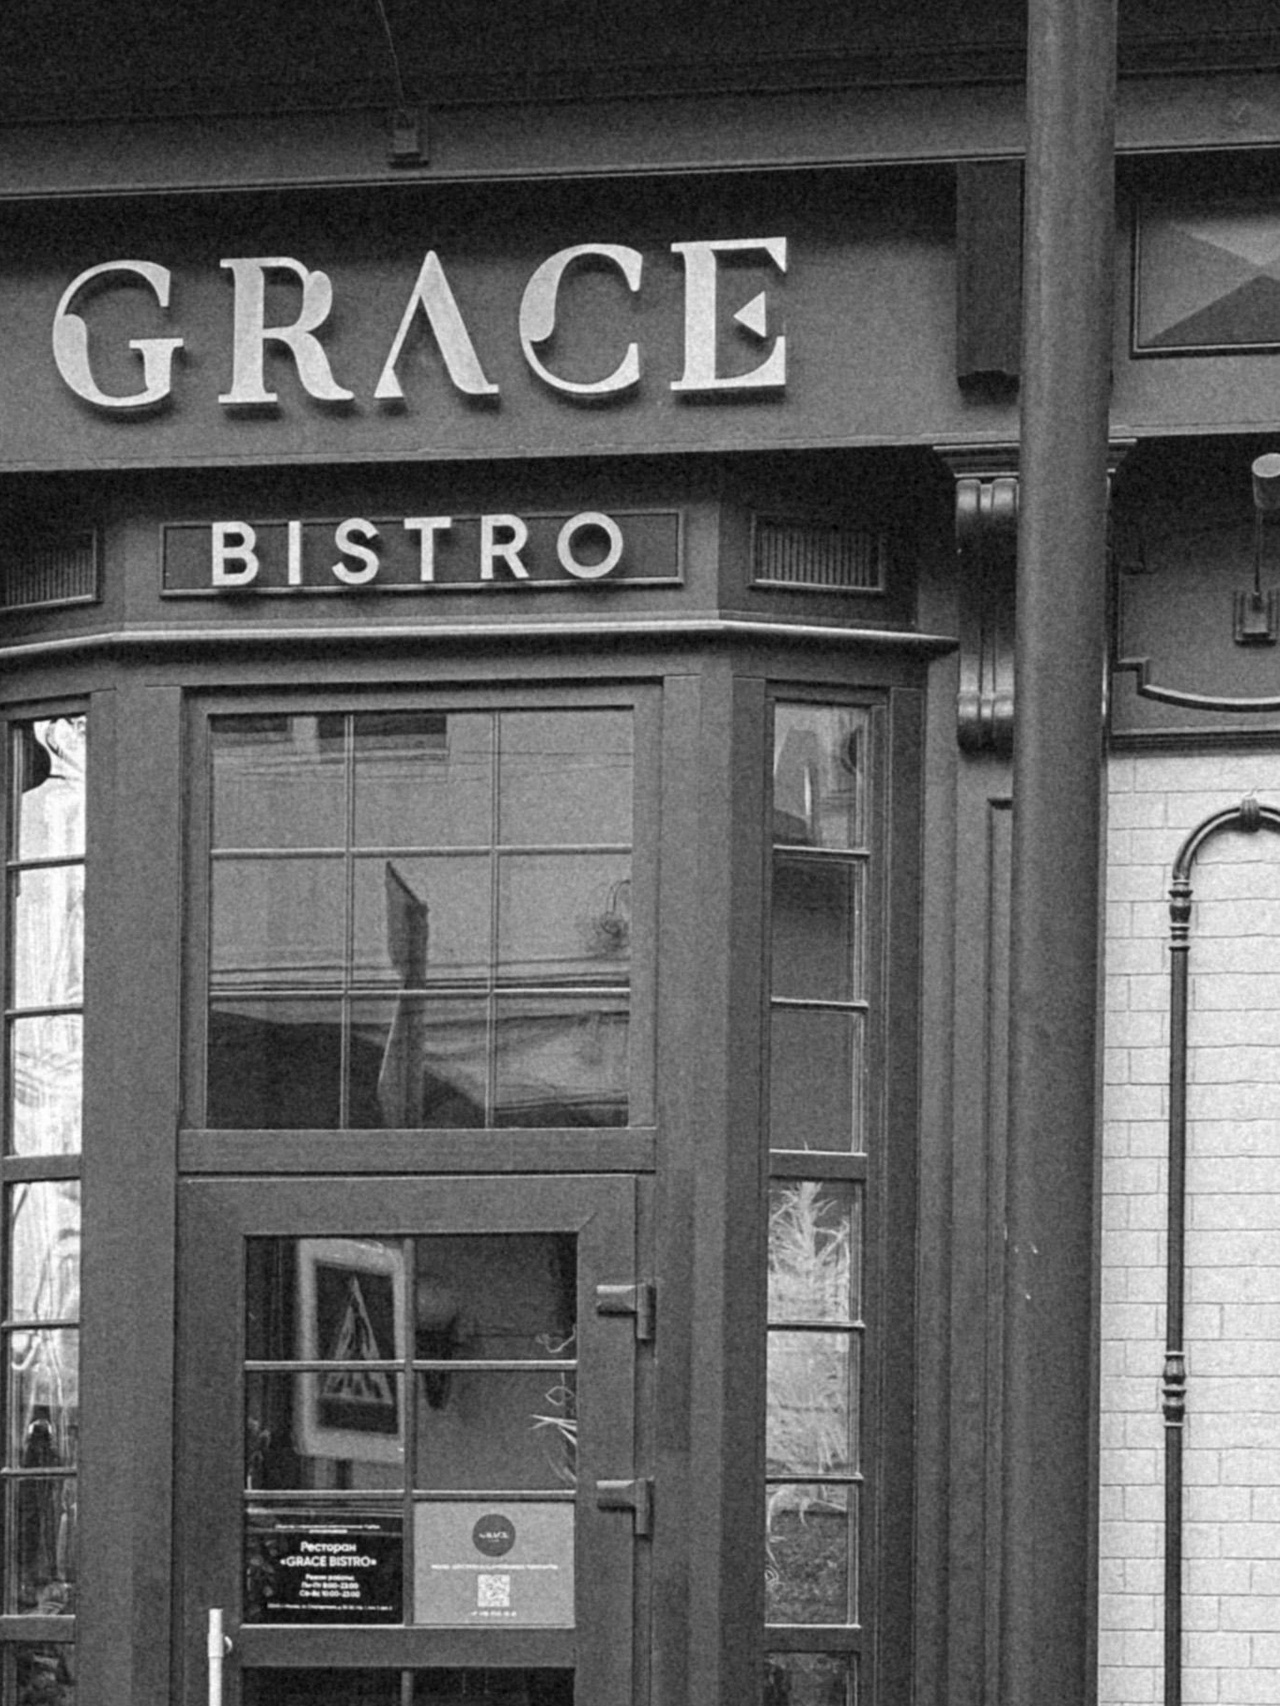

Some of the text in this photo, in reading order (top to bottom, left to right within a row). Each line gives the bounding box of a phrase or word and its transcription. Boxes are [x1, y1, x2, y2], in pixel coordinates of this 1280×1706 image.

[52, 236, 787, 408] GRACE
[210, 511, 624, 586] BISTRO
[300, 1541, 357, 1554] Ресторан
